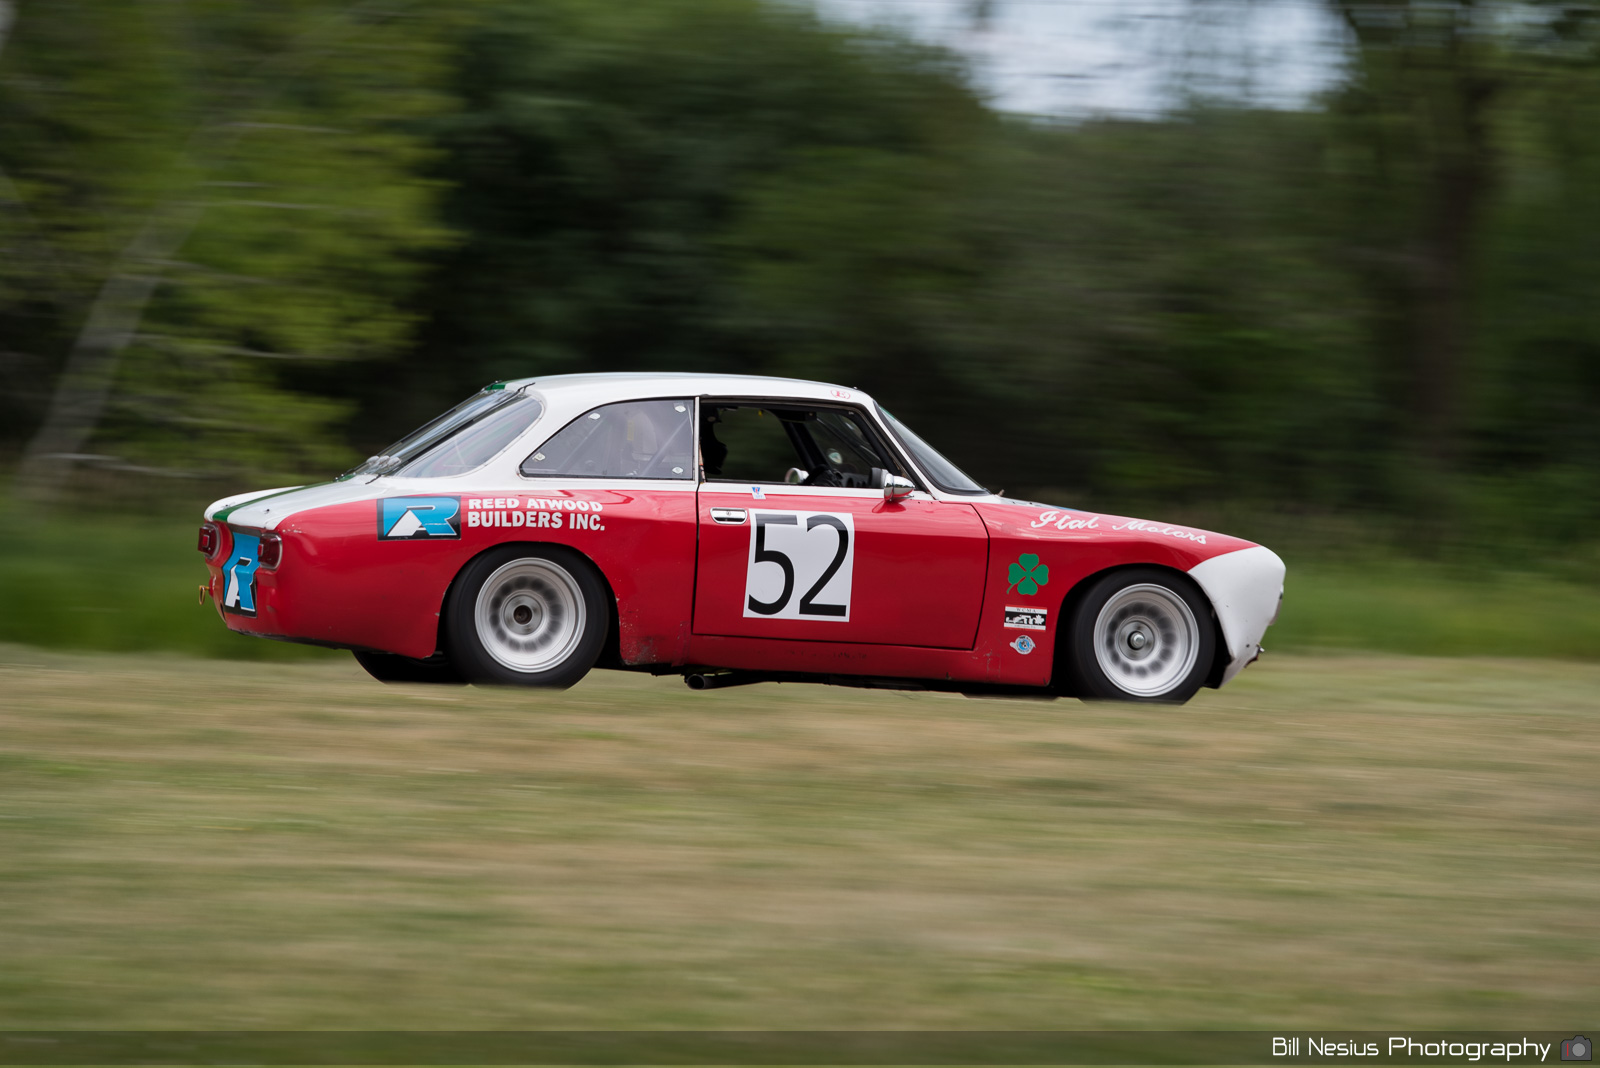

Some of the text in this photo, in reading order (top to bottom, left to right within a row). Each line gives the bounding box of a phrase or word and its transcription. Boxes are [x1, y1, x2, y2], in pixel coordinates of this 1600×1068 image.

[468, 498, 604, 512] REED ATWOOD
[467, 510, 606, 531] BUILDERS INC.
[1030, 510, 1207, 545] Ital Motors
[748, 513, 849, 617] 52
